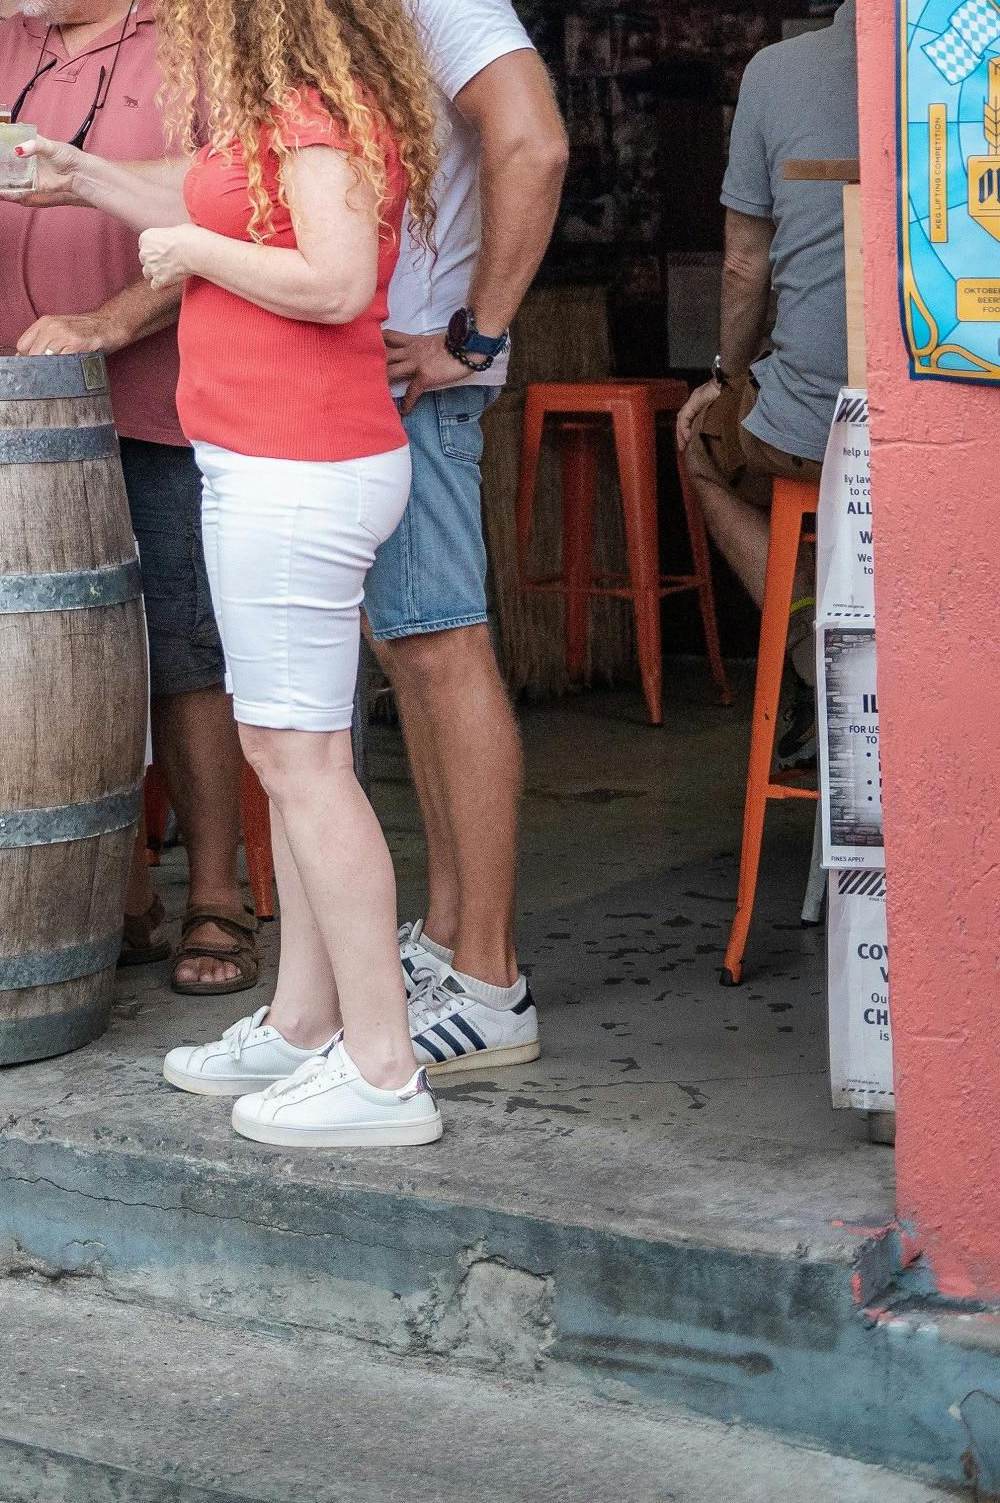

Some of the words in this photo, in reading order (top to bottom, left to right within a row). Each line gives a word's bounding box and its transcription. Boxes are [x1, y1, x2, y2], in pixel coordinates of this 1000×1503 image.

[934, 117, 942, 175] COMPETITION
[850, 488, 860, 496] to
[847, 501, 872, 515] ALL
[857, 553, 873, 563] We
[864, 566, 874, 575] to
[849, 725, 866, 734] FOR
[865, 736, 878, 745] TO
[863, 1008, 888, 1026] CH
[879, 1030, 890, 1042] is
